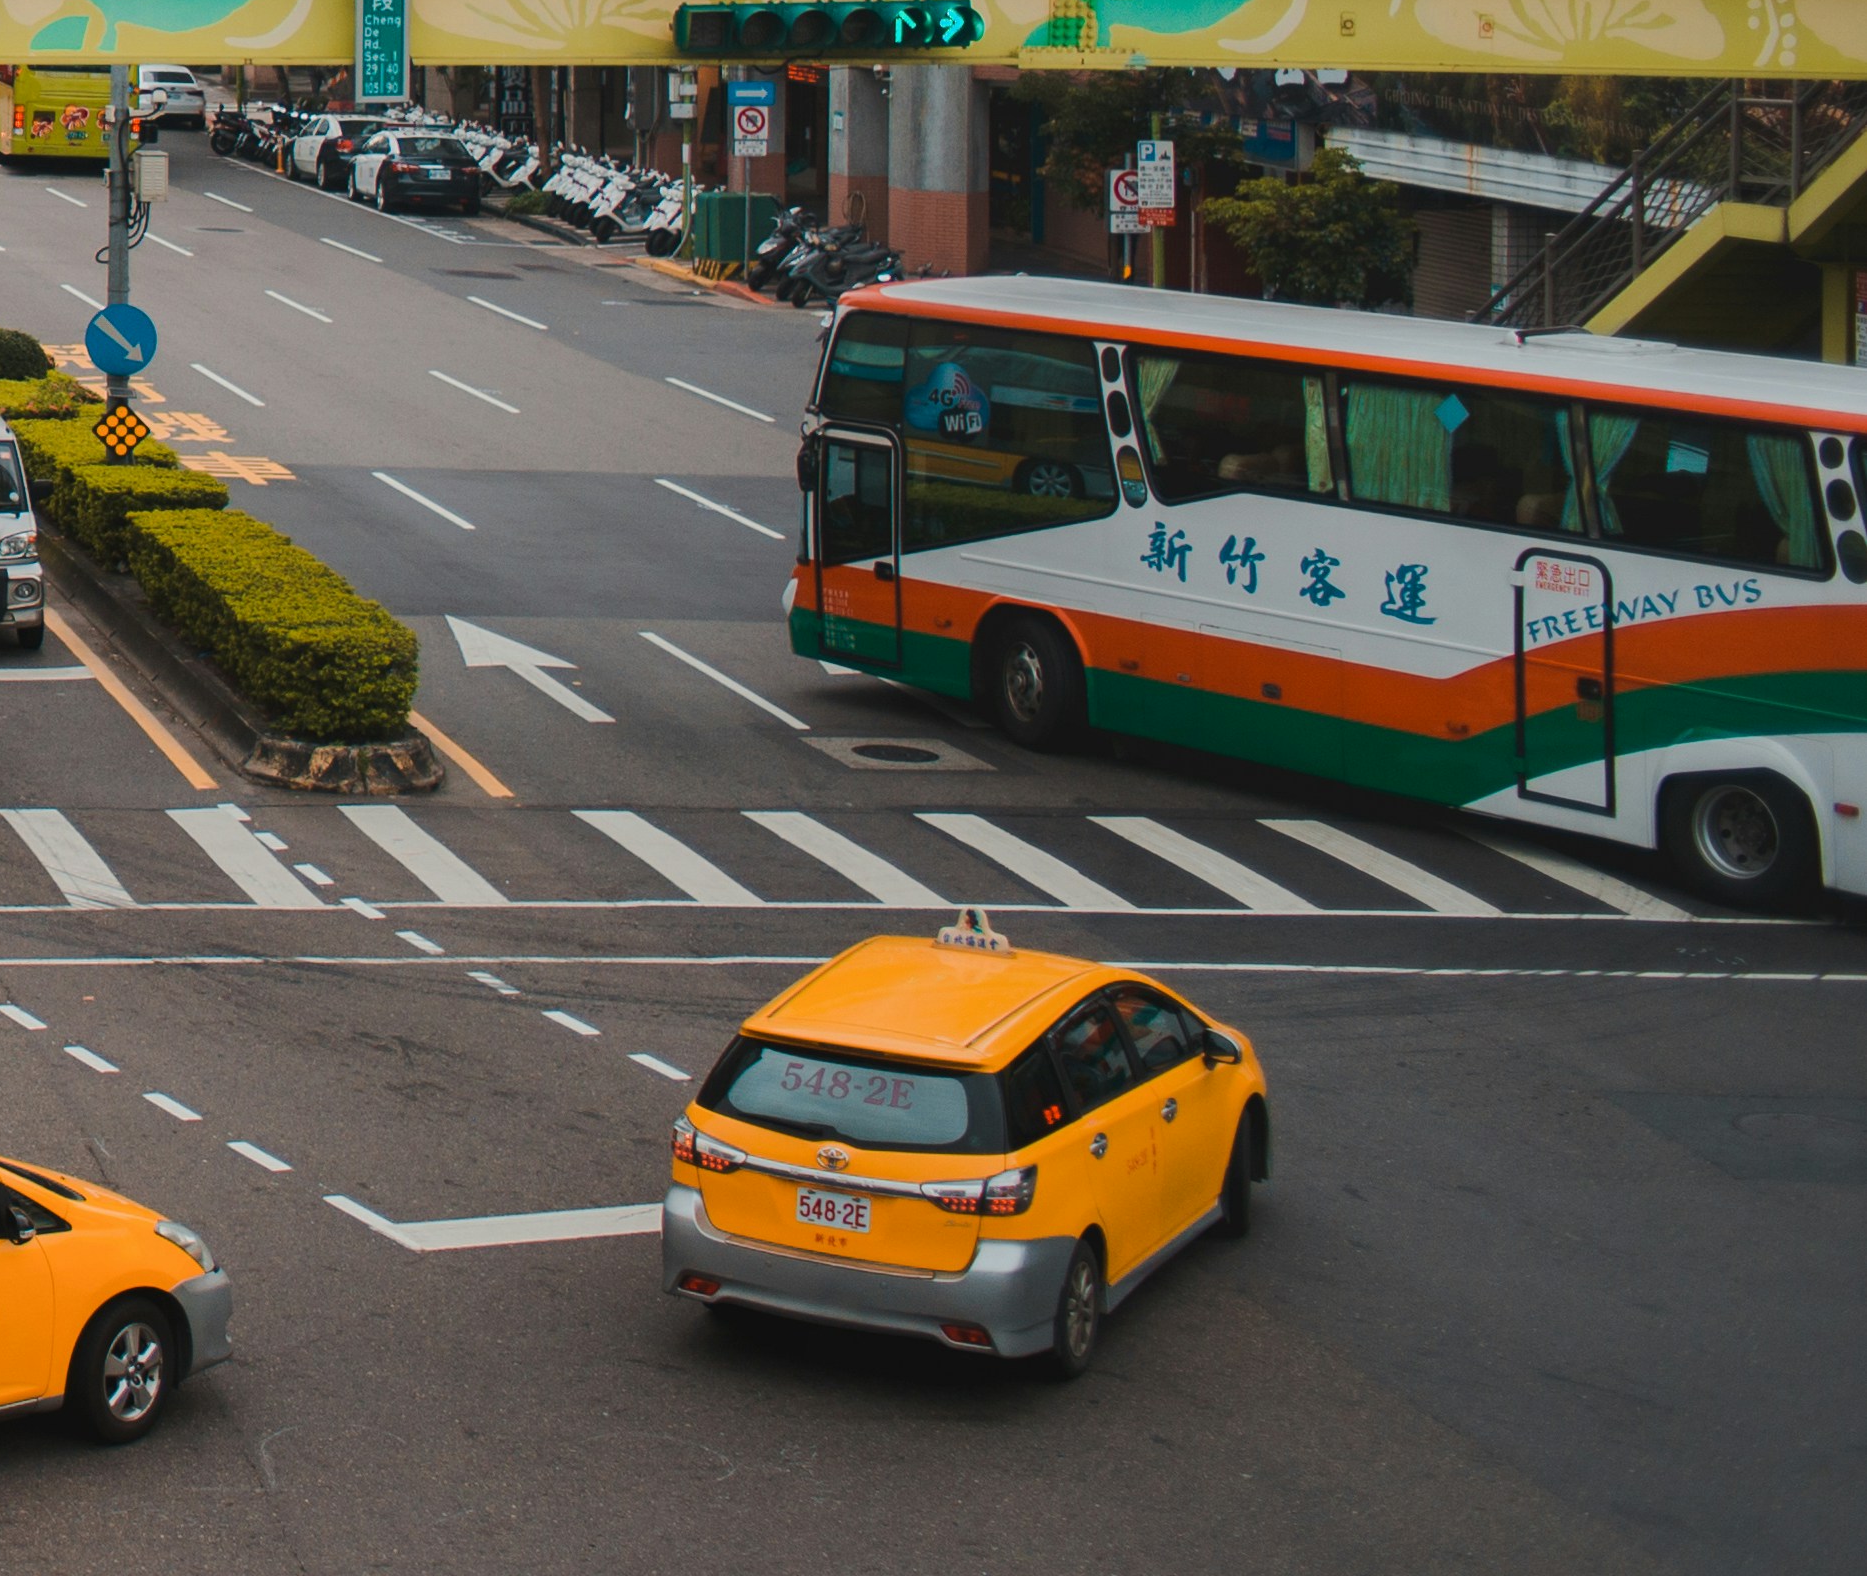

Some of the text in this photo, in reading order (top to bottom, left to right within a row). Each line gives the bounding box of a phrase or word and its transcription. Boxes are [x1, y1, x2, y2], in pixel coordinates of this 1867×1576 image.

[365, 14, 401, 28] Cheng
[365, 27, 379, 37] De
[365, 39, 382, 50] Rd.
[365, 50, 397, 62] Sec. 1
[366, 63, 378, 75] 29
[386, 63, 398, 75] 40
[365, 82, 378, 93] 105
[386, 82, 398, 93] 90
[1384, 87, 1431, 107] GUIDING
[1435, 93, 1456, 109] THE
[928, 388, 954, 407] 4G
[1140, 520, 1439, 625] 新竹客運
[1536, 560, 1591, 588] 緊急出口
[1535, 580, 1590, 597] EMERGENCY EXIT
[1526, 578, 1763, 643] FREEWAY BUS
[780, 1061, 915, 1110] 548-2E
[799, 1194, 869, 1229] 548-2E
